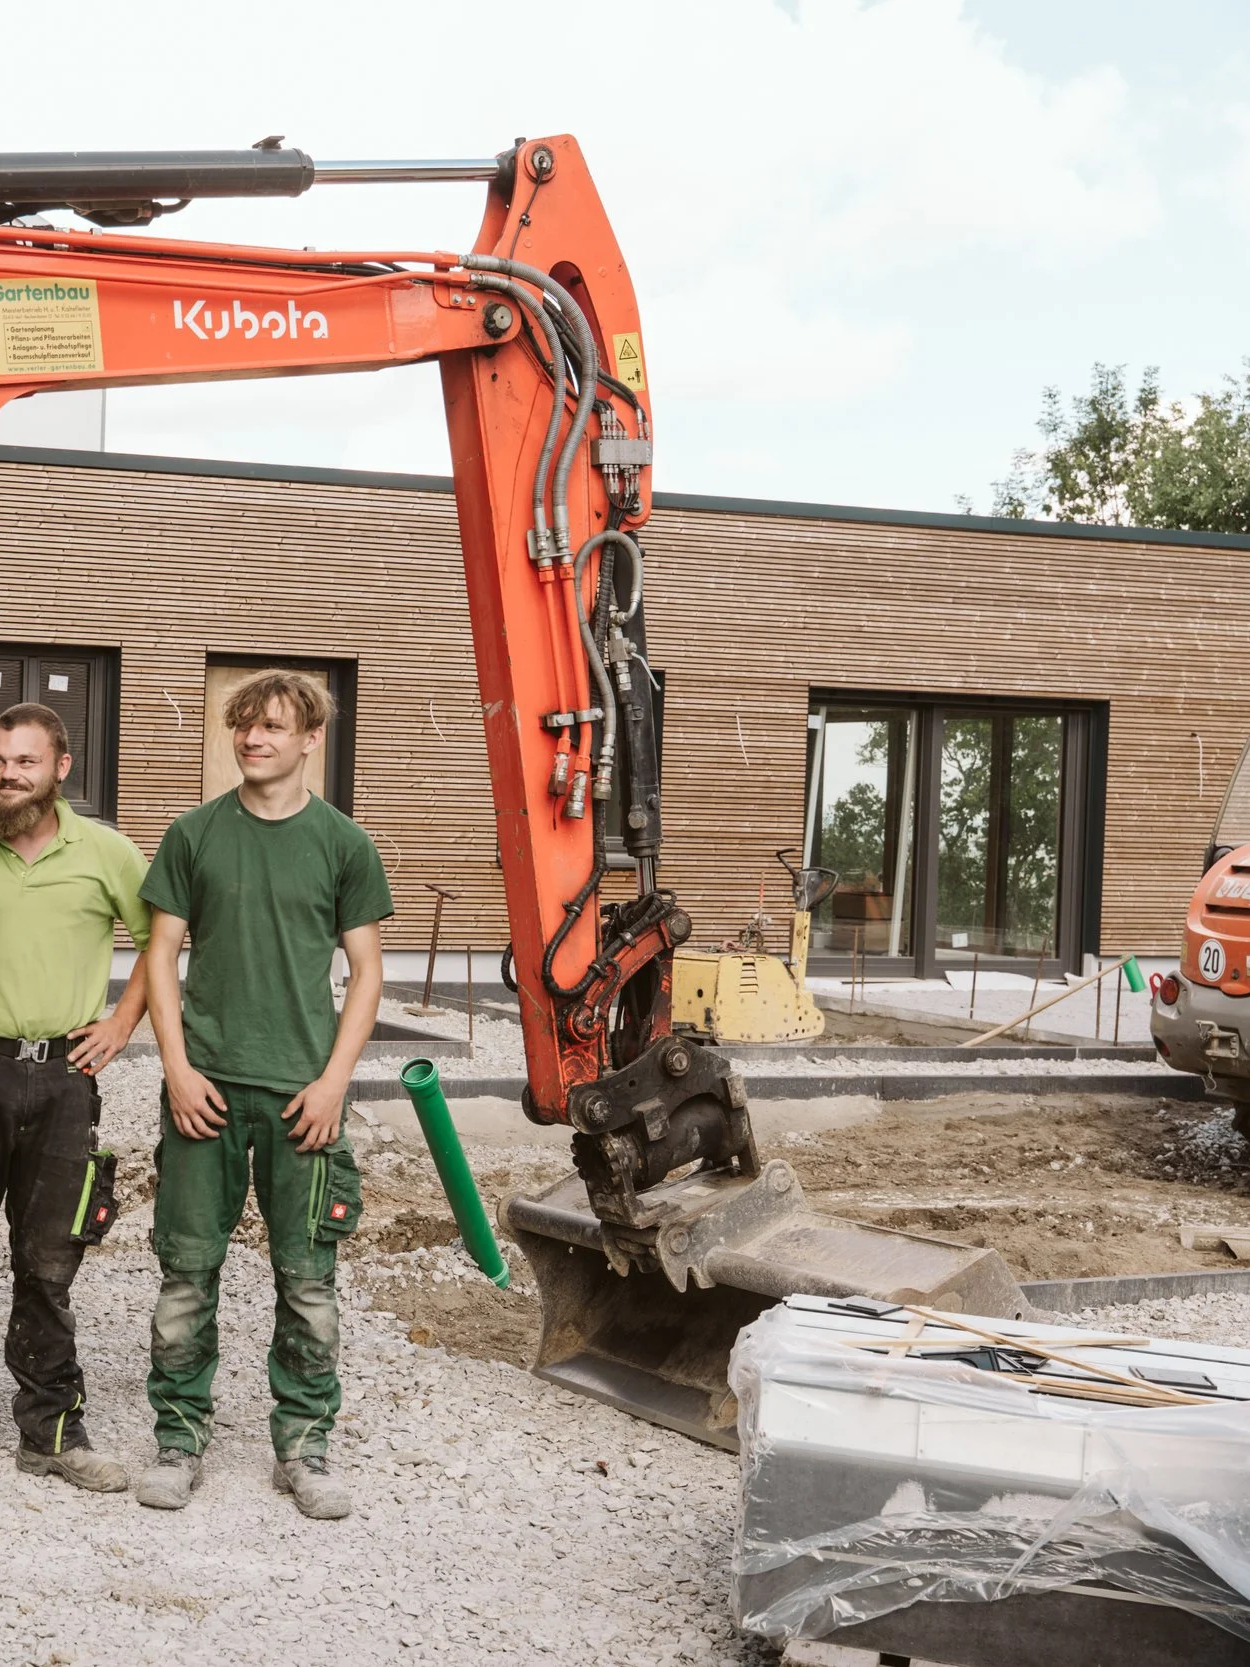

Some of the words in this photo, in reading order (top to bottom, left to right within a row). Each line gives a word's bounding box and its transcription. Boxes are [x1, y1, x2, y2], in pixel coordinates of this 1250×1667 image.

[173, 299, 329, 340] Kubota
[12, 344, 39, 352] Anlagen-
[46, 343, 92, 351] Friedhofspflege
[12, 352, 91, 361] Baumschulpflanzenverkauf
[1203, 946, 1220, 974] 20
